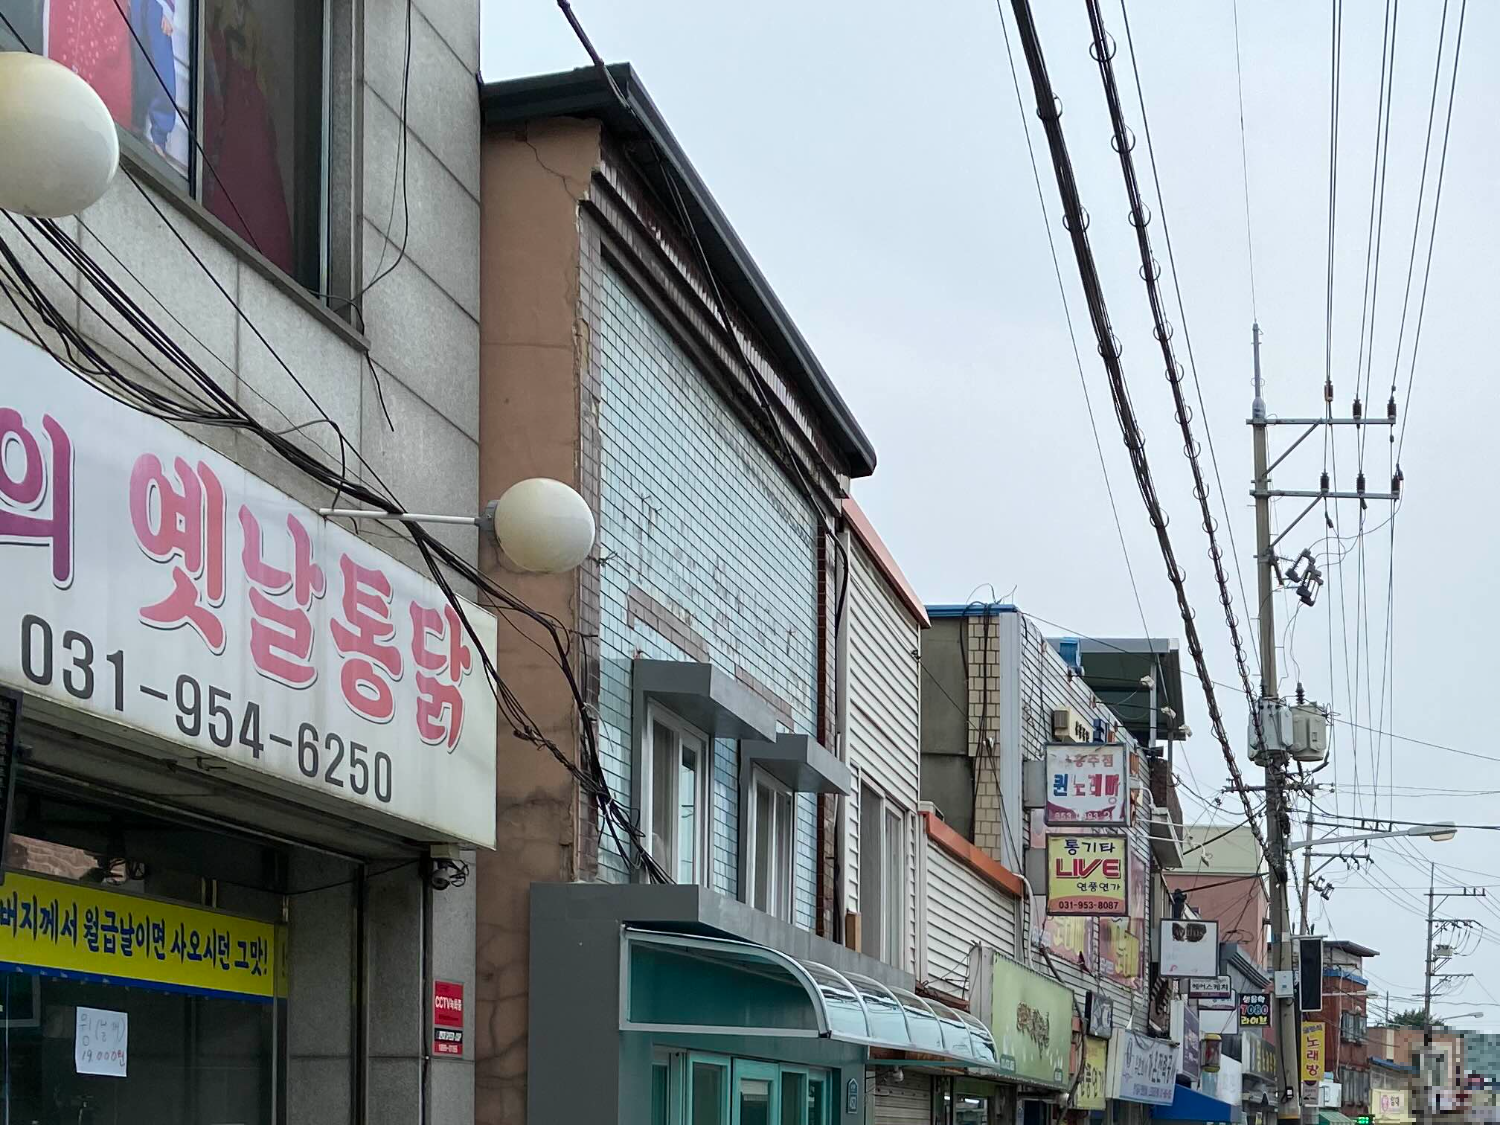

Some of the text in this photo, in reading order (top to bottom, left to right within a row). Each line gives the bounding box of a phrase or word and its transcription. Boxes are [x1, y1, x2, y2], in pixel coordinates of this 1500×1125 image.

[129, 452, 475, 754] 옛날통닭
[21, 614, 392, 802] 031-954-6250
[1064, 839, 1116, 855] 통기타
[1056, 858, 1122, 879] LIVE
[1076, 881, 1121, 893] 연풍연가
[1058, 901, 1119, 910] 031-953-8087
[83, 904, 166, 960] 월급날이면
[170, 921, 231, 971] 사오시던
[234, 935, 268, 976] 그맛!
[1240, 1016, 1268, 1025] 라이브
[1306, 1035, 1320, 1076] 노래방
